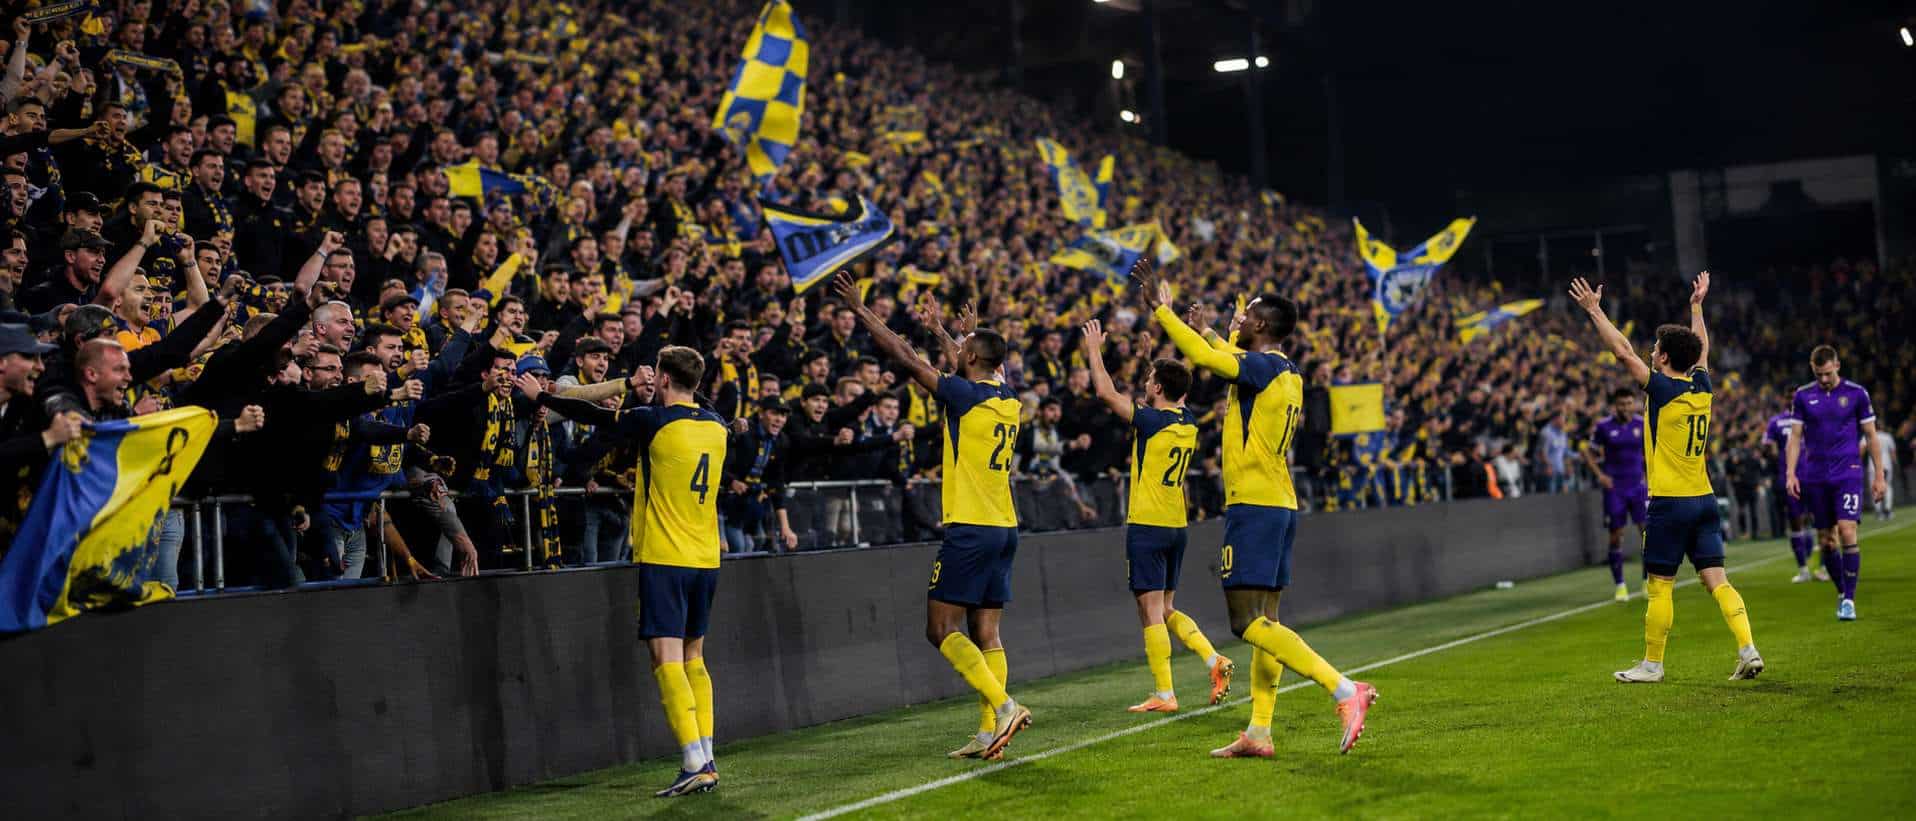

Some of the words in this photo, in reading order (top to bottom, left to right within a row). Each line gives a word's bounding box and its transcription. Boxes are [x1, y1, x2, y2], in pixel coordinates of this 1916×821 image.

[989, 423, 1017, 471] 23
[1685, 415, 1708, 456] 19
[690, 453, 710, 505] 4
[1161, 447, 1193, 487] 20
